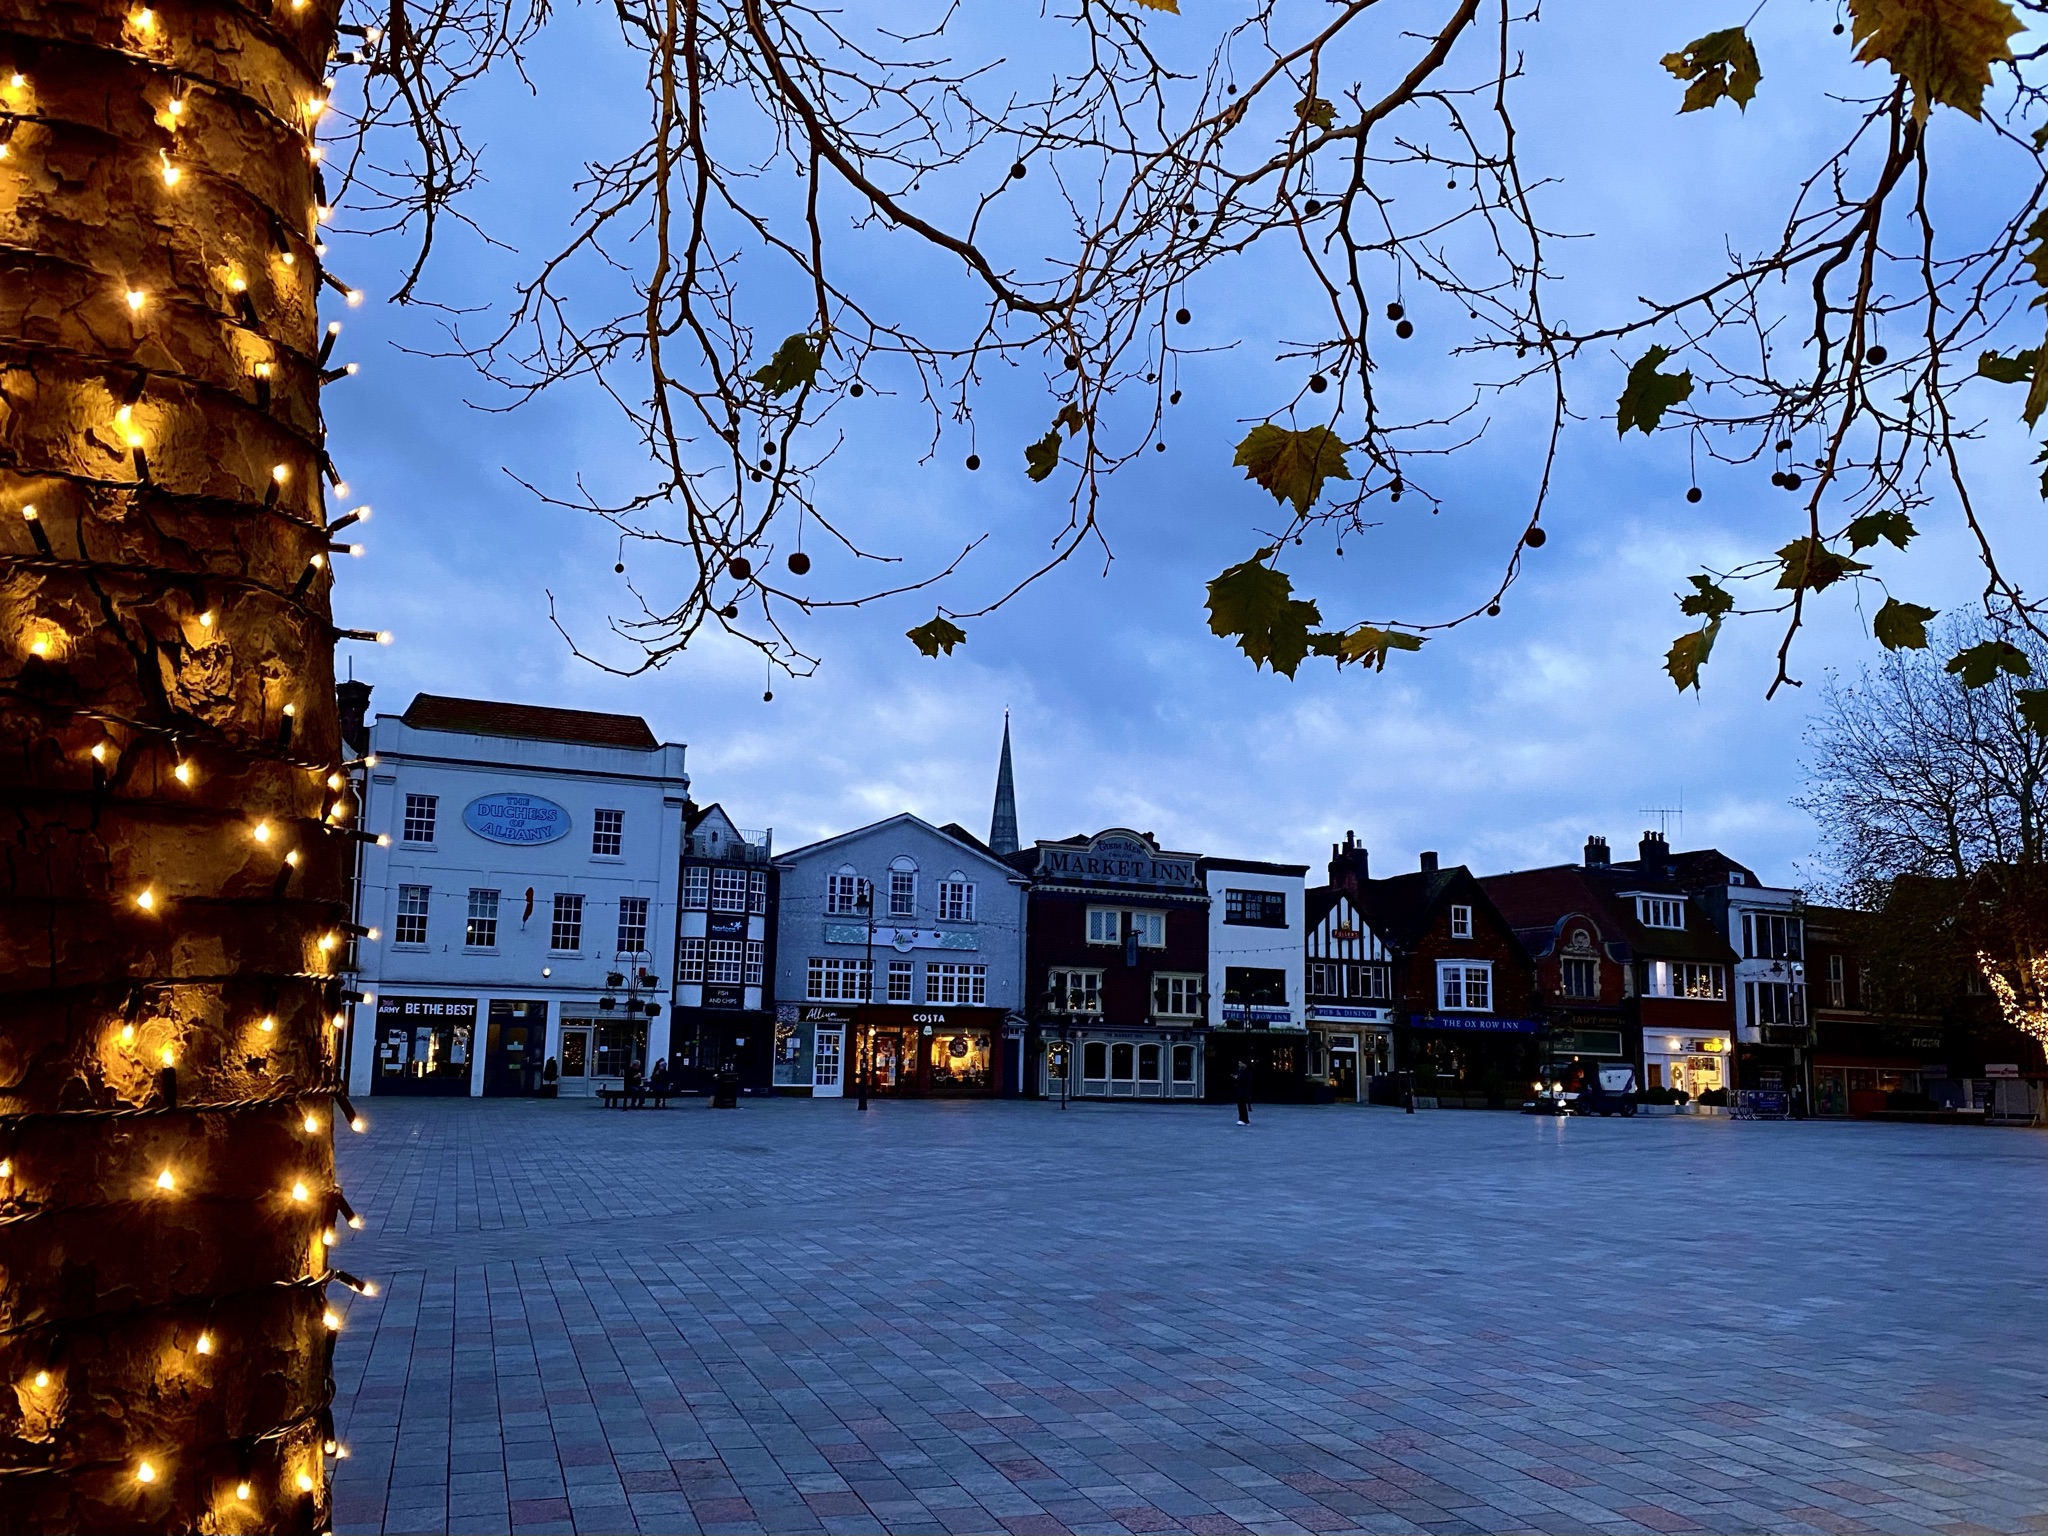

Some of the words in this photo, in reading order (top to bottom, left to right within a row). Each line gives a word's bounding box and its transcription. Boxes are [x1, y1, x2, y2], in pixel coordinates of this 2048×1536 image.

[506, 797, 530, 806] THE
[477, 803, 558, 821] DUCHESS
[509, 819, 525, 828] OF
[480, 822, 552, 841] ALBANY
[1049, 852, 1145, 878] MARKET
[1150, 860, 1190, 881] INN
[378, 1006, 400, 1014] ARMY
[405, 1003, 421, 1014] BE
[422, 1003, 444, 1015] THE
[446, 1004, 475, 1016] BEST
[805, 1007, 838, 1022] Allium
[1344, 1010, 1373, 1018] DINING
[912, 1013, 946, 1023] COSTA
[1443, 1019, 1461, 1027] THE
[1464, 1020, 1477, 1028] OX
[1479, 1021, 1500, 1029] ROW
[1502, 1022, 1519, 1030] INN
